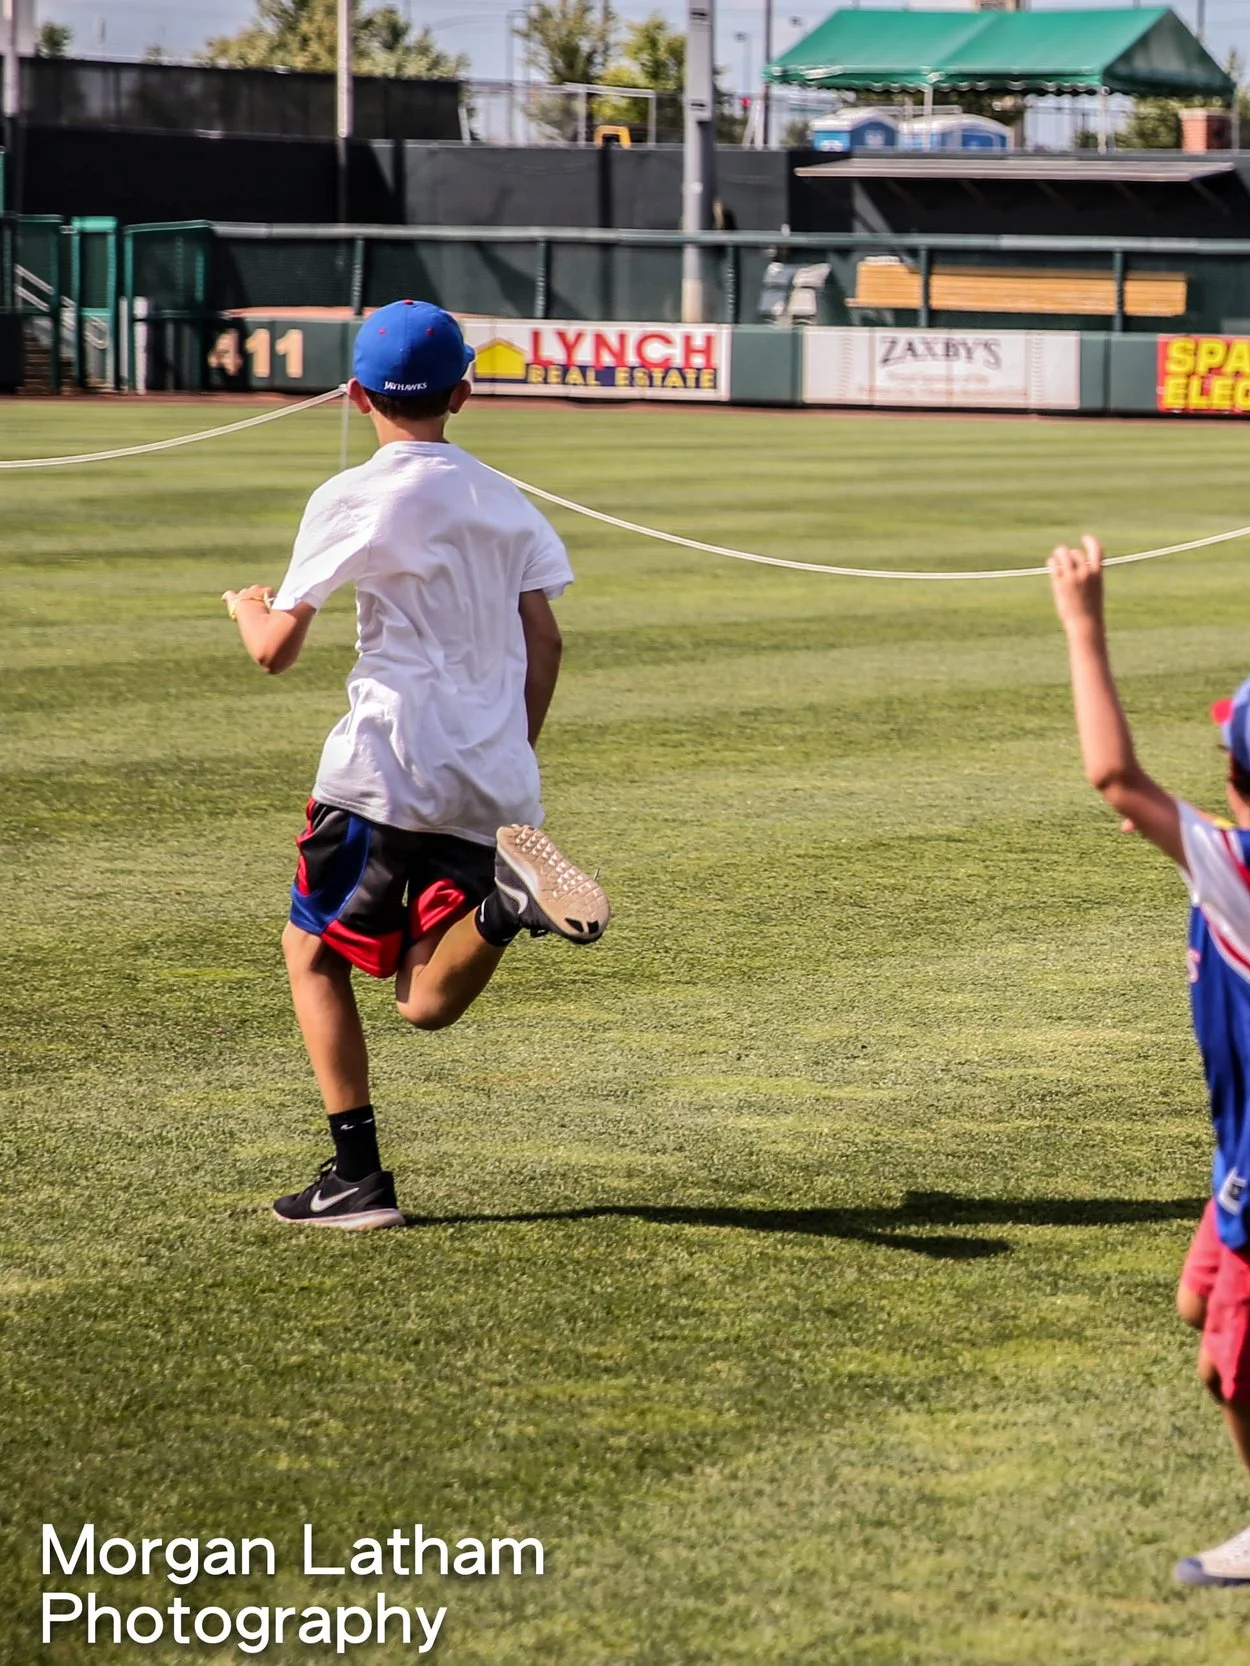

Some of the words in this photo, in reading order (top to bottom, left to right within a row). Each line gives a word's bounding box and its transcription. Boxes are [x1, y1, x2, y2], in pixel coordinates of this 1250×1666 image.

[207, 328, 304, 378] 411
[531, 328, 715, 370] LYNCH
[880, 336, 1002, 371] ZAXBY'S
[527, 364, 601, 386] REAL
[614, 366, 716, 389] ESTATE
